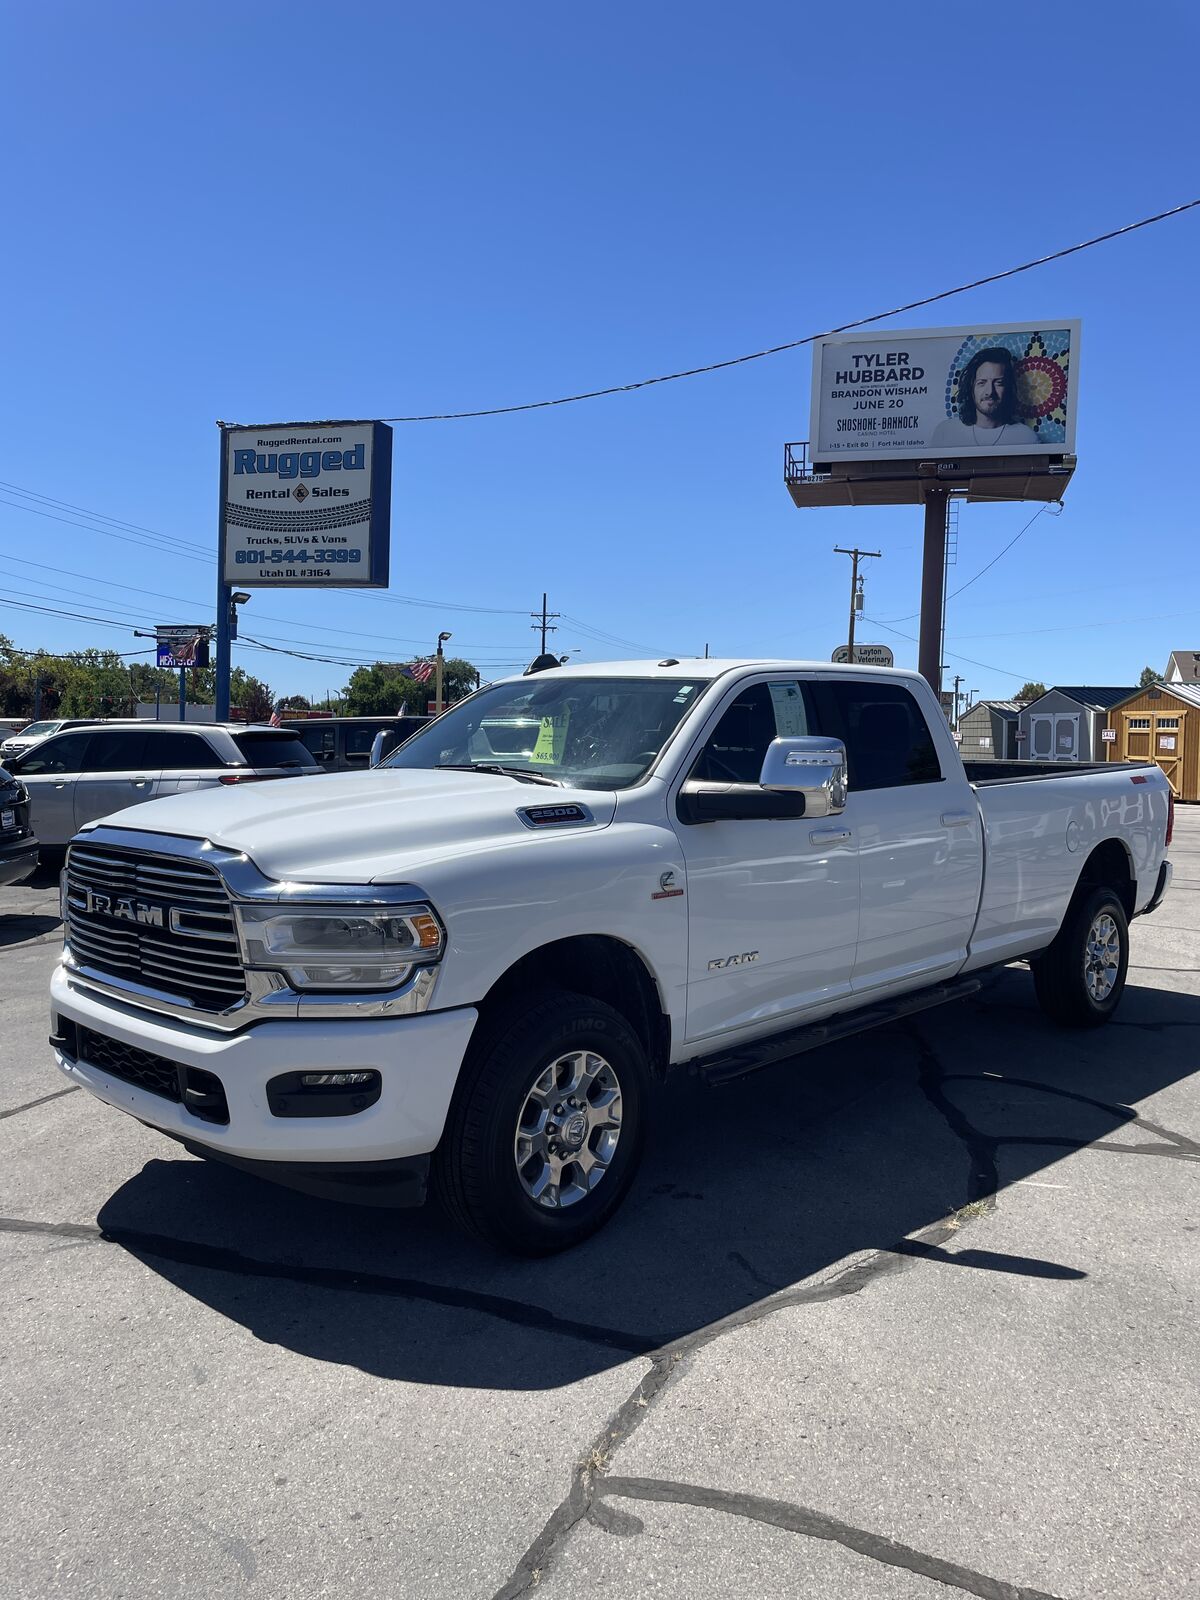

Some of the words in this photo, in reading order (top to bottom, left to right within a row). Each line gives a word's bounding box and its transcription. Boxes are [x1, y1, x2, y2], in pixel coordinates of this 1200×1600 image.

[852, 352, 910, 368] TYLER
[835, 367, 925, 384] HUBBARD
[831, 388, 882, 399] BRANDON
[884, 386, 928, 396] WISHAM
[853, 399, 885, 410] JUNE
[888, 399, 904, 408] 20
[257, 436, 342, 448] RuggedRental.com
[233, 443, 365, 480] Rugged
[246, 487, 290, 500] Rental
[296, 488, 305, 498] &
[311, 486, 350, 498] Sales
[246, 536, 282, 545] Trucks,
[283, 535, 310, 544] SUVs
[311, 535, 319, 543] &
[321, 535, 347, 544] Vans
[235, 548, 362, 564] 801-544-3399
[259, 569, 284, 578] Utah
[285, 569, 298, 577] DL
[300, 568, 331, 577] #3164
[859, 648, 882, 656] Layton
[857, 655, 891, 665] Veterinary
[531, 807, 578, 819] 2500
[90, 892, 163, 927] RAM
[707, 950, 760, 972] RAM
